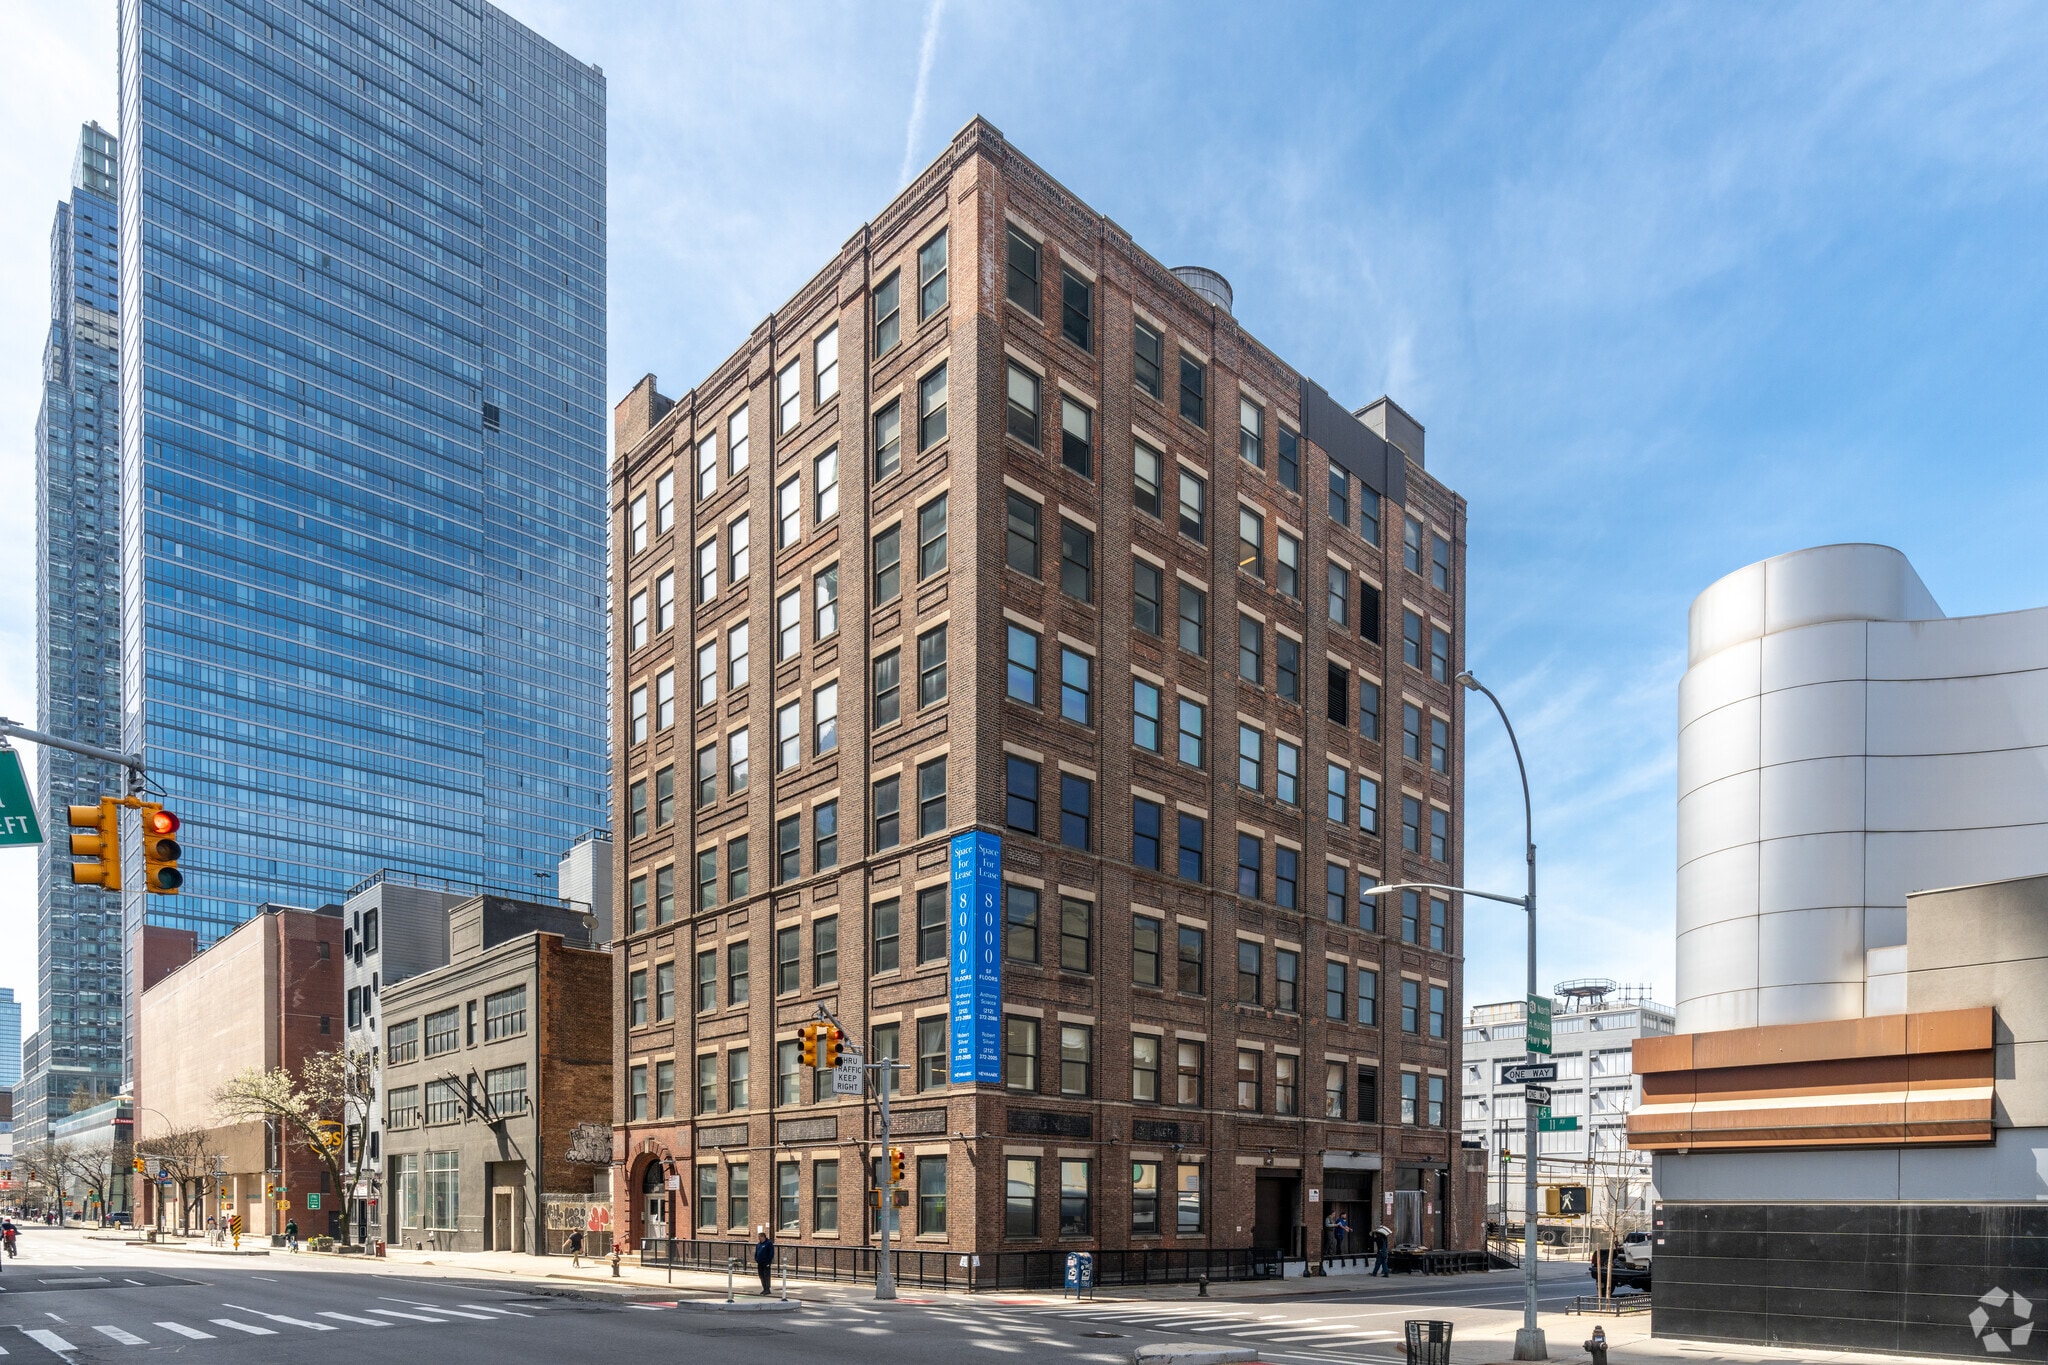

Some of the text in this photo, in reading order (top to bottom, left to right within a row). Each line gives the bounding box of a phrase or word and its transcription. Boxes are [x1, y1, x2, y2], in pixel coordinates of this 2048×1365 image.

[955, 847, 972, 859] Space
[979, 844, 999, 857] Space
[958, 860, 969, 869] For
[983, 858, 995, 868] For
[955, 870, 972, 880] Lease
[979, 867, 999, 880] Lease
[979, 974, 998, 983] FLOORS
[1537, 1004, 1550, 1016] North
[1528, 1034, 1540, 1048] Pkwy
[838, 1074, 857, 1082] KEEP
[1509, 1069, 1550, 1079] ONE WAY
[837, 1082, 858, 1091] RIGHT
[1528, 1090, 1537, 1099] ONE
[1540, 1107, 1547, 1118] 45
[1549, 1119, 1556, 1130] 11
